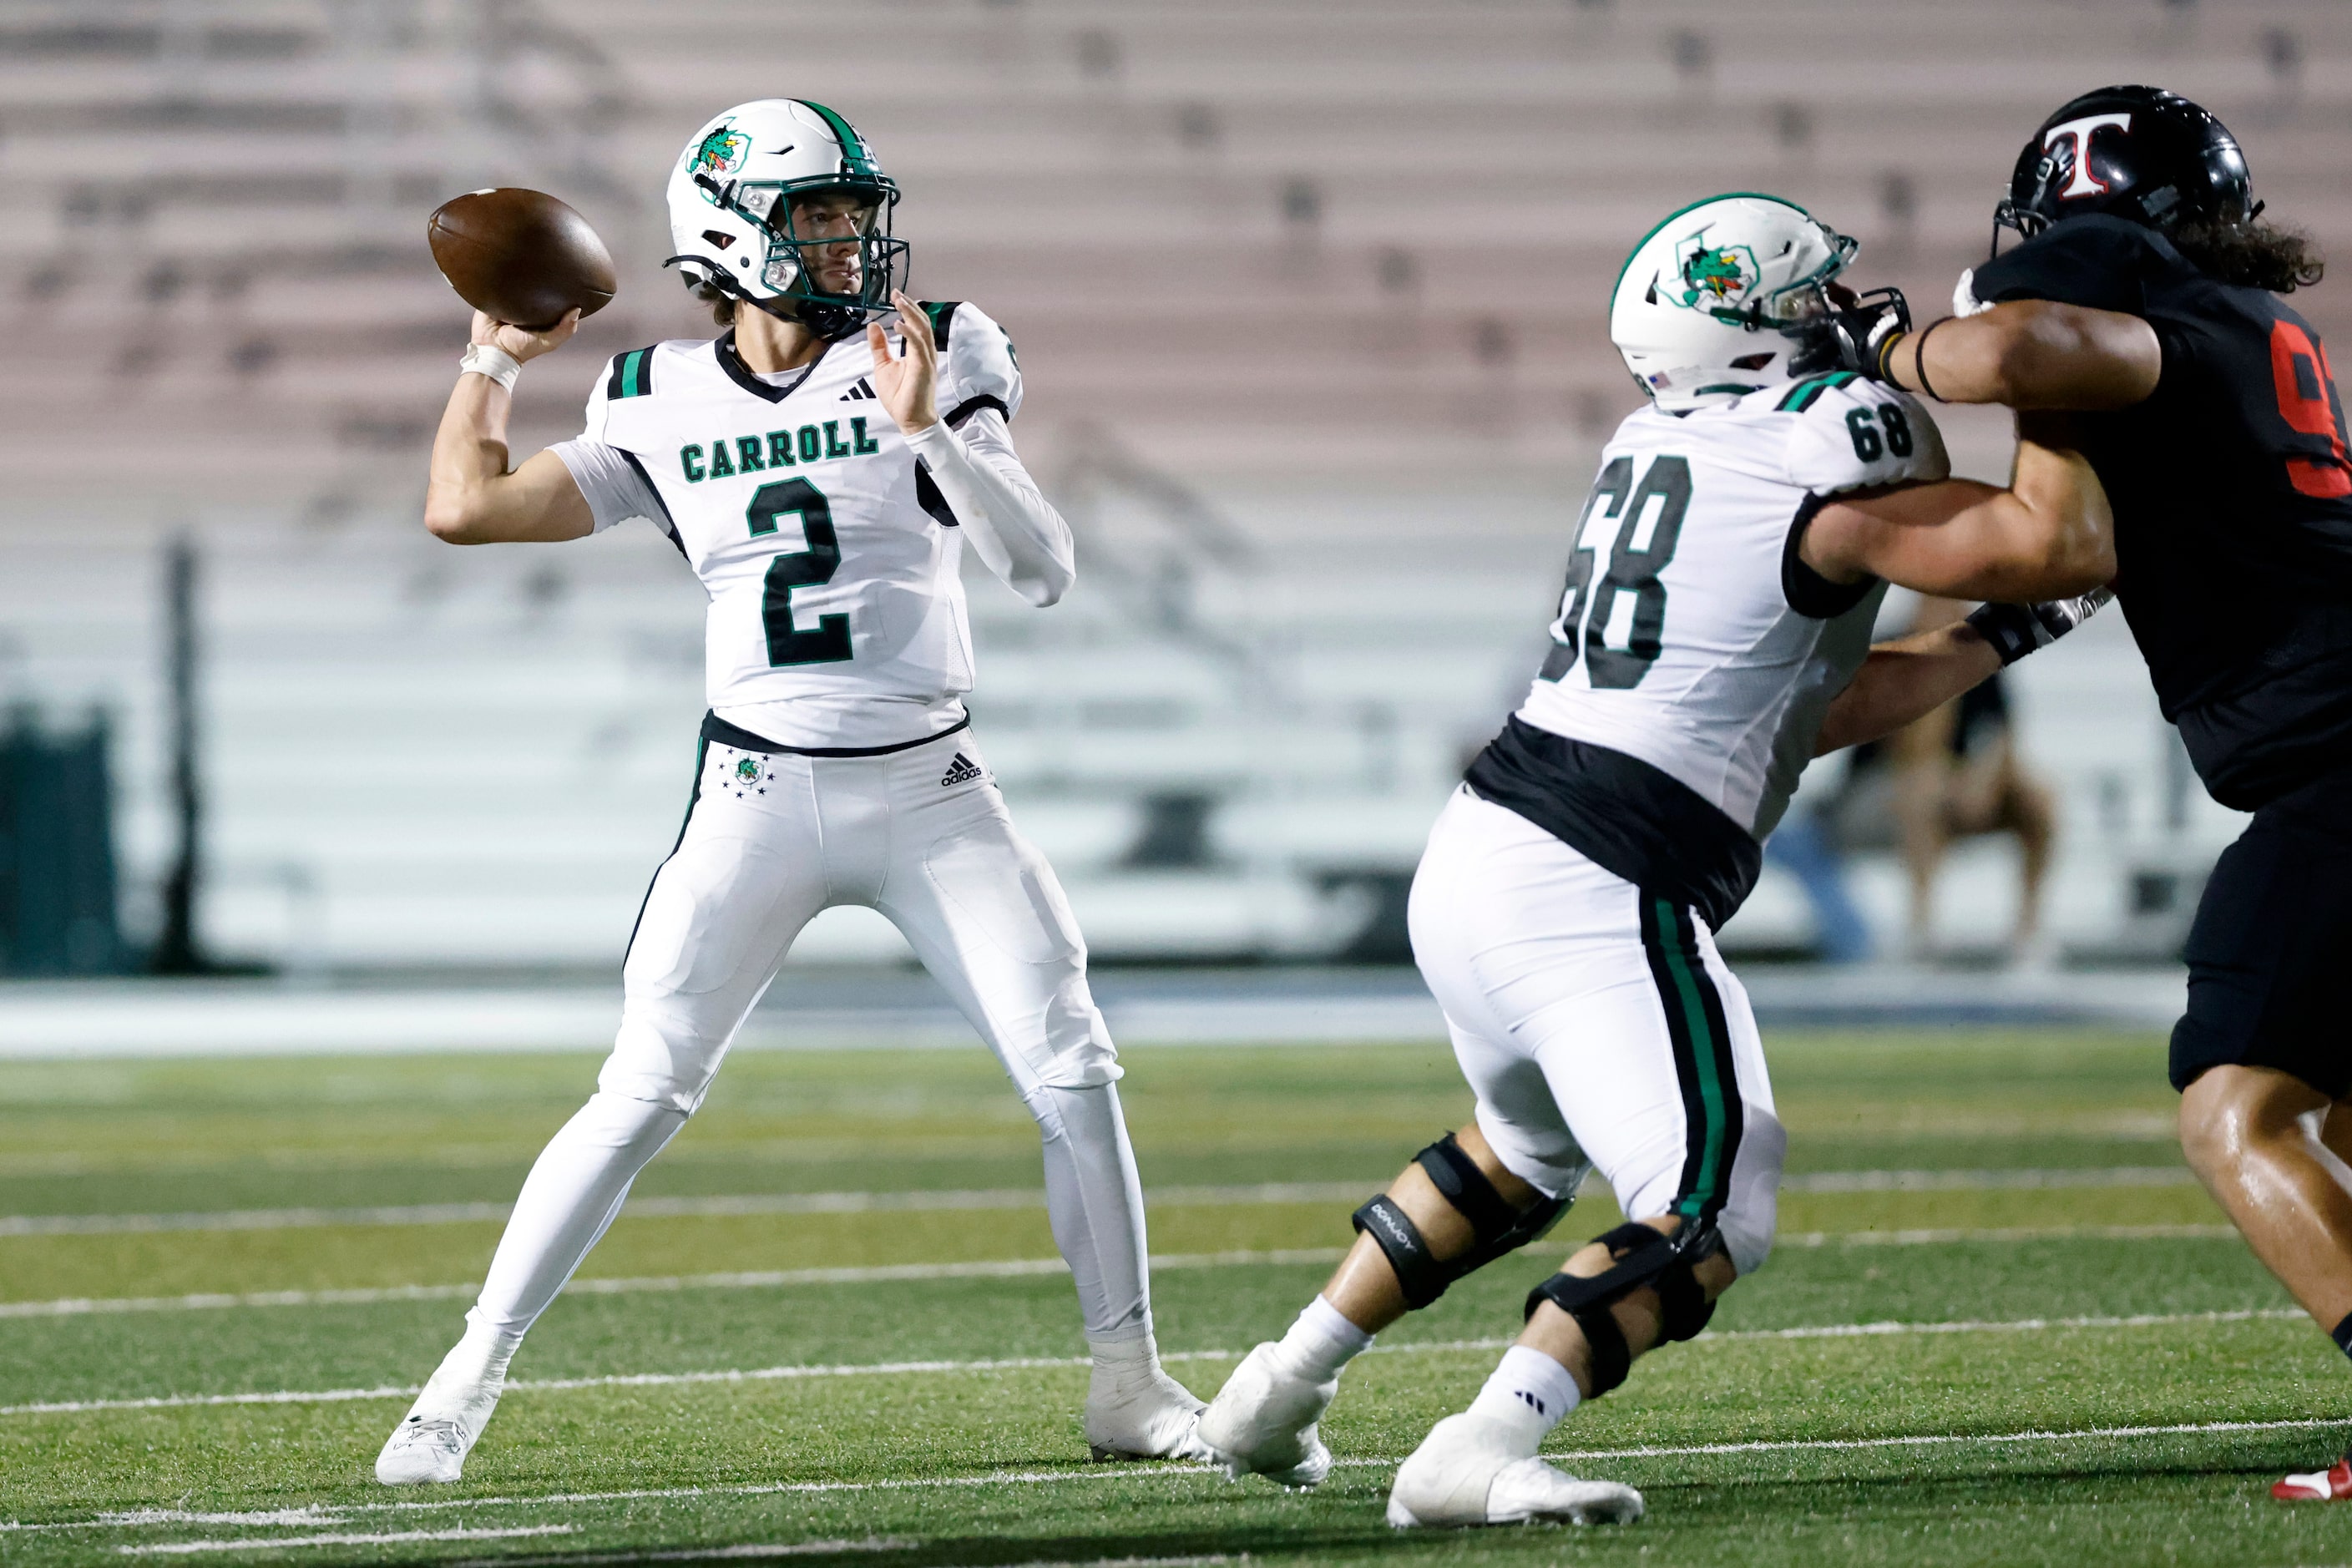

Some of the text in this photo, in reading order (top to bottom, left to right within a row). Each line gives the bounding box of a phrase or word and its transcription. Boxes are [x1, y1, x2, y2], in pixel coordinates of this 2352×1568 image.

[2041, 112, 2133, 200] T
[1845, 402, 1913, 463] 68
[2270, 318, 2352, 498] 9
[680, 417, 879, 483] CARROLL
[746, 475, 853, 668] 2
[1539, 454, 1692, 689] 68
[941, 766, 982, 787] adidas
[1371, 1203, 1418, 1252] DONJOY
